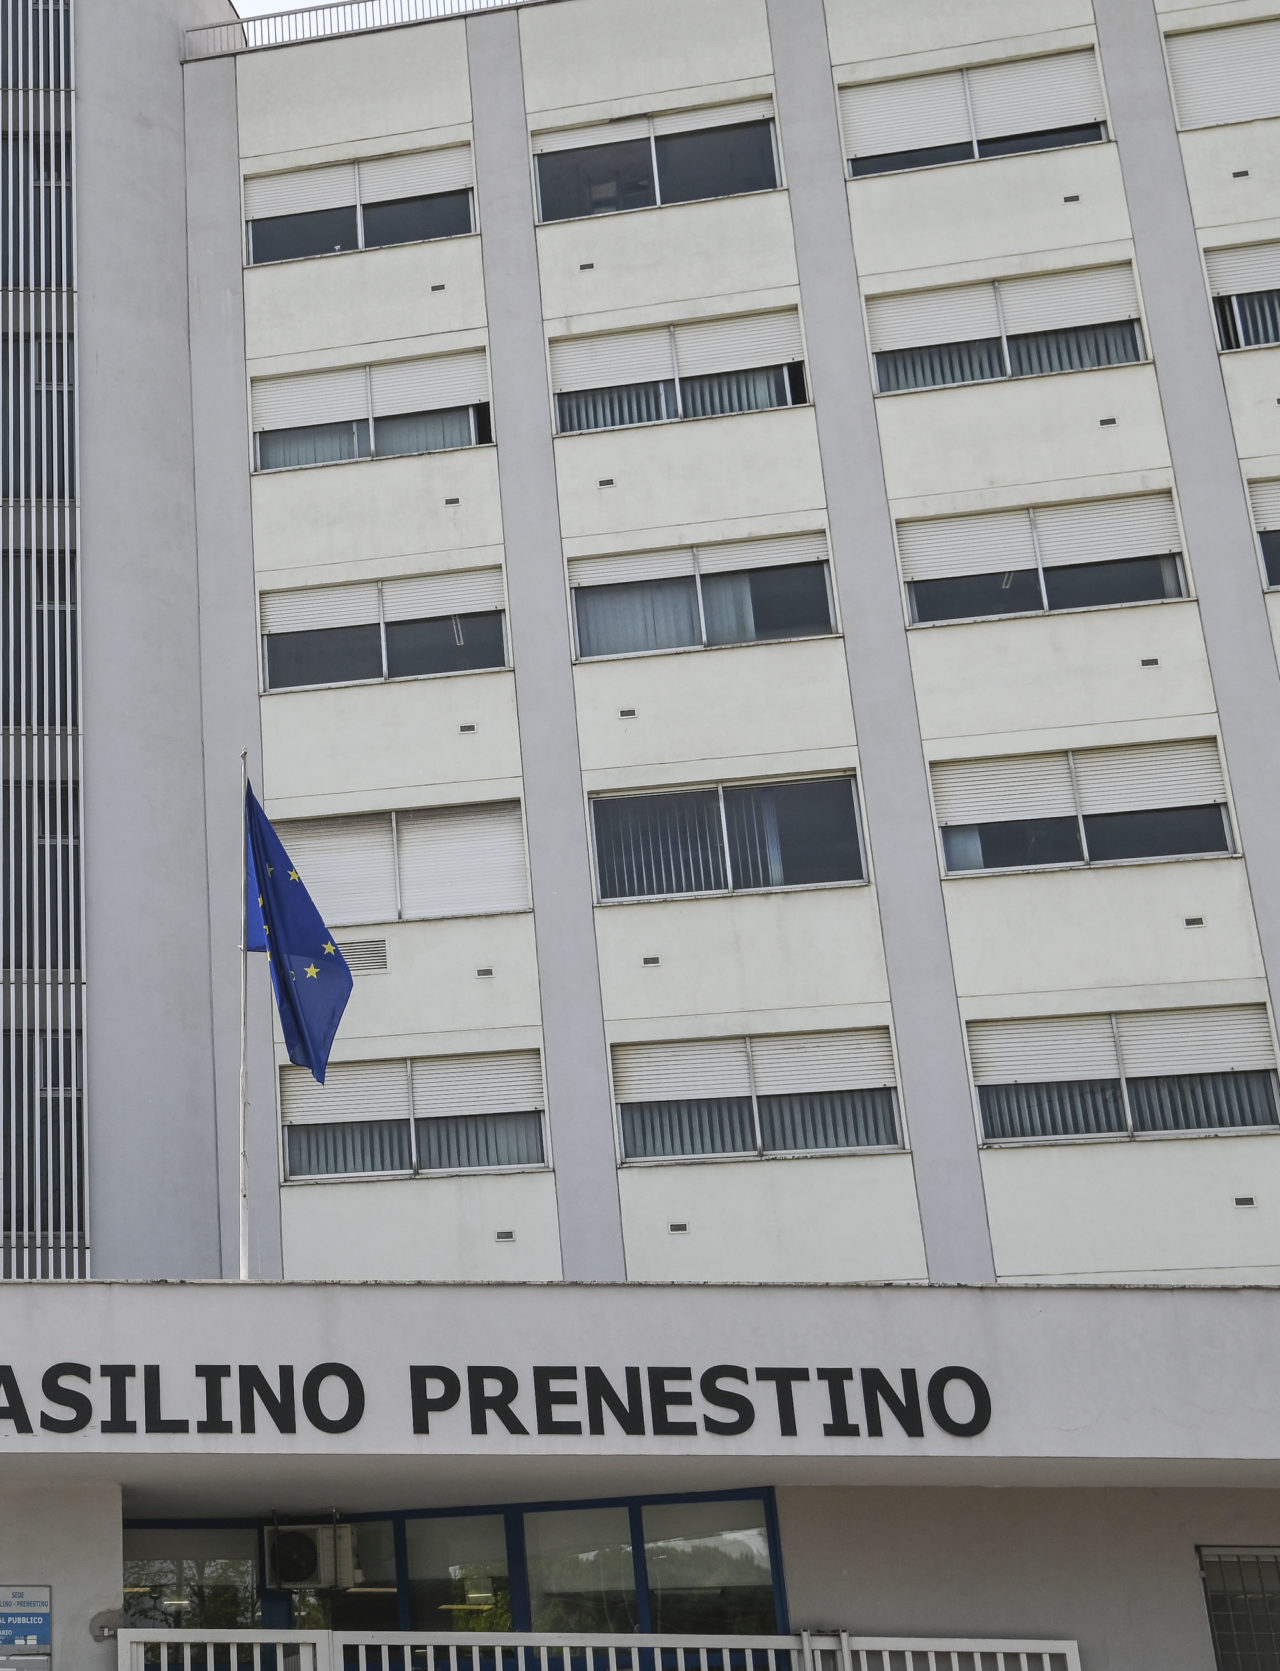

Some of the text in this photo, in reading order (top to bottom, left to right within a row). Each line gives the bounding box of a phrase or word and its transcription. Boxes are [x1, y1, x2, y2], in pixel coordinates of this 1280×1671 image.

[409, 1364, 992, 1439] PRENESTINO
[11, 1591, 24, 1599] SEDE
[7, 1616, 43, 1624] PUBBLICO
